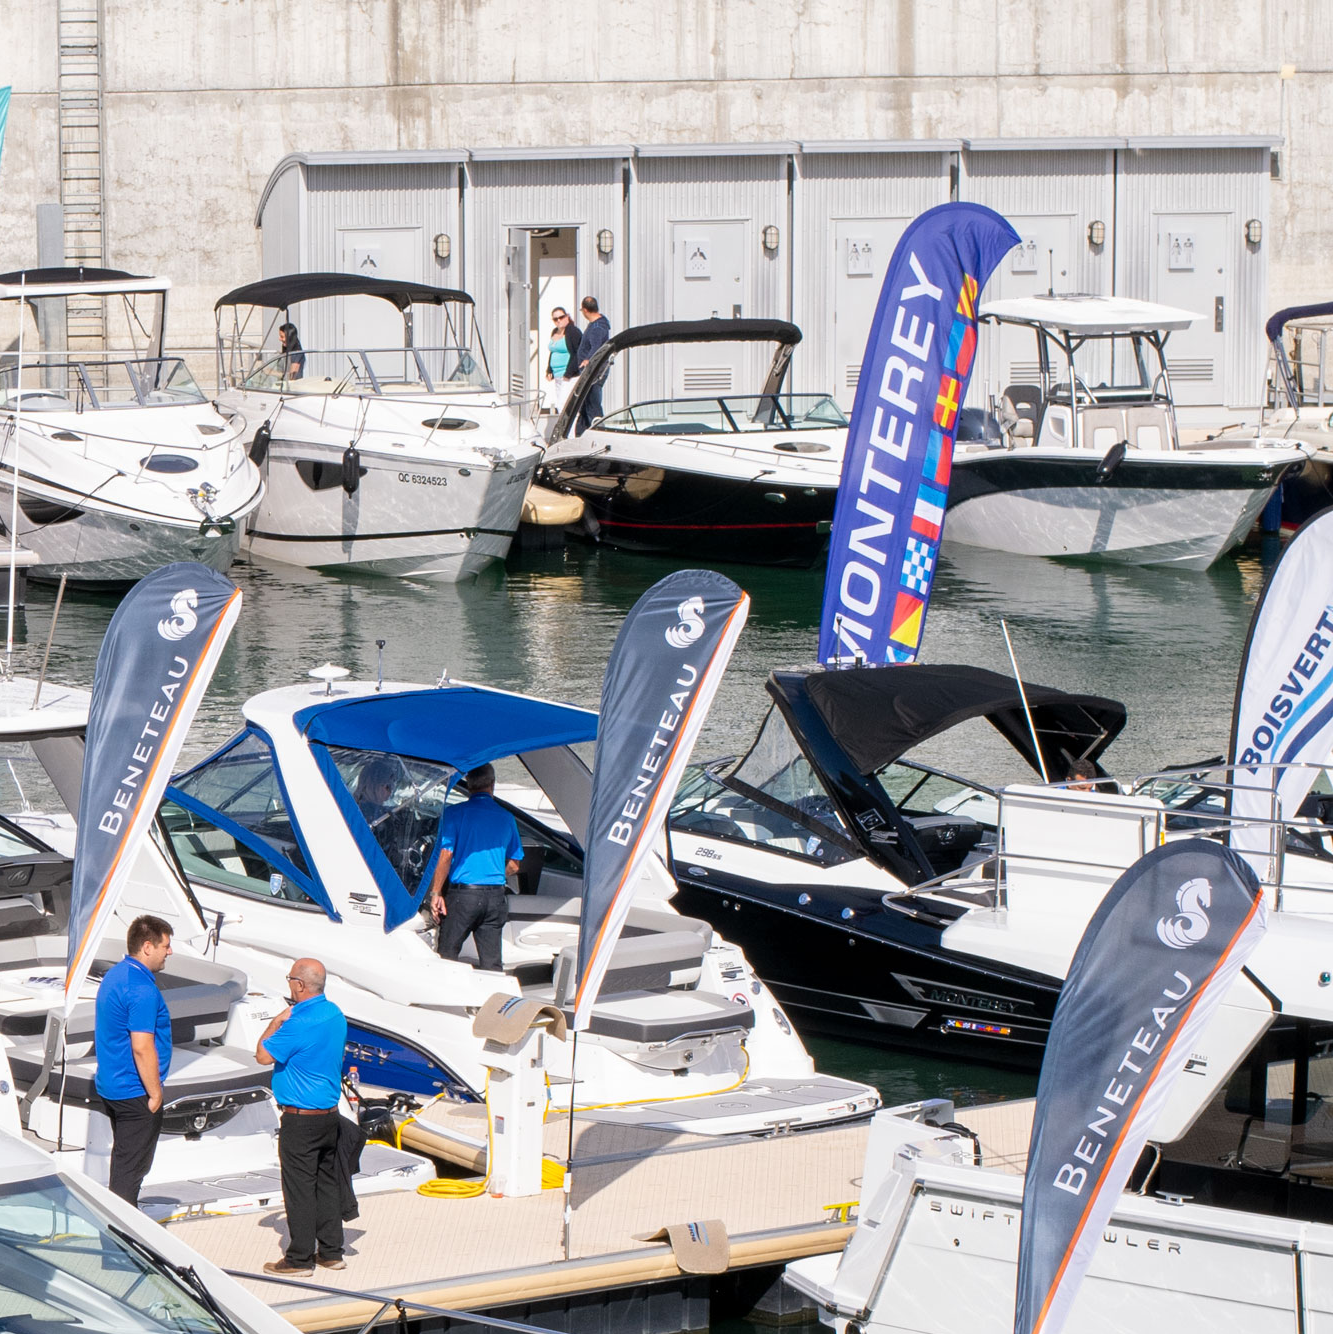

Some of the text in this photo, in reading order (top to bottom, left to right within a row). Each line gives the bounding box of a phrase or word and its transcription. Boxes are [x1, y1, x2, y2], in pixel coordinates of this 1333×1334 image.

[397, 472, 448, 487] QC 6324523
[827, 250, 944, 665] MONTEREY
[97, 655, 189, 836] BENETEAU
[606, 663, 698, 847] BENETEAU
[1238, 604, 1333, 776] BOISVERT
[1052, 970, 1193, 1196] BENETEAU
[930, 1200, 1182, 1256] SWIFT WLER
